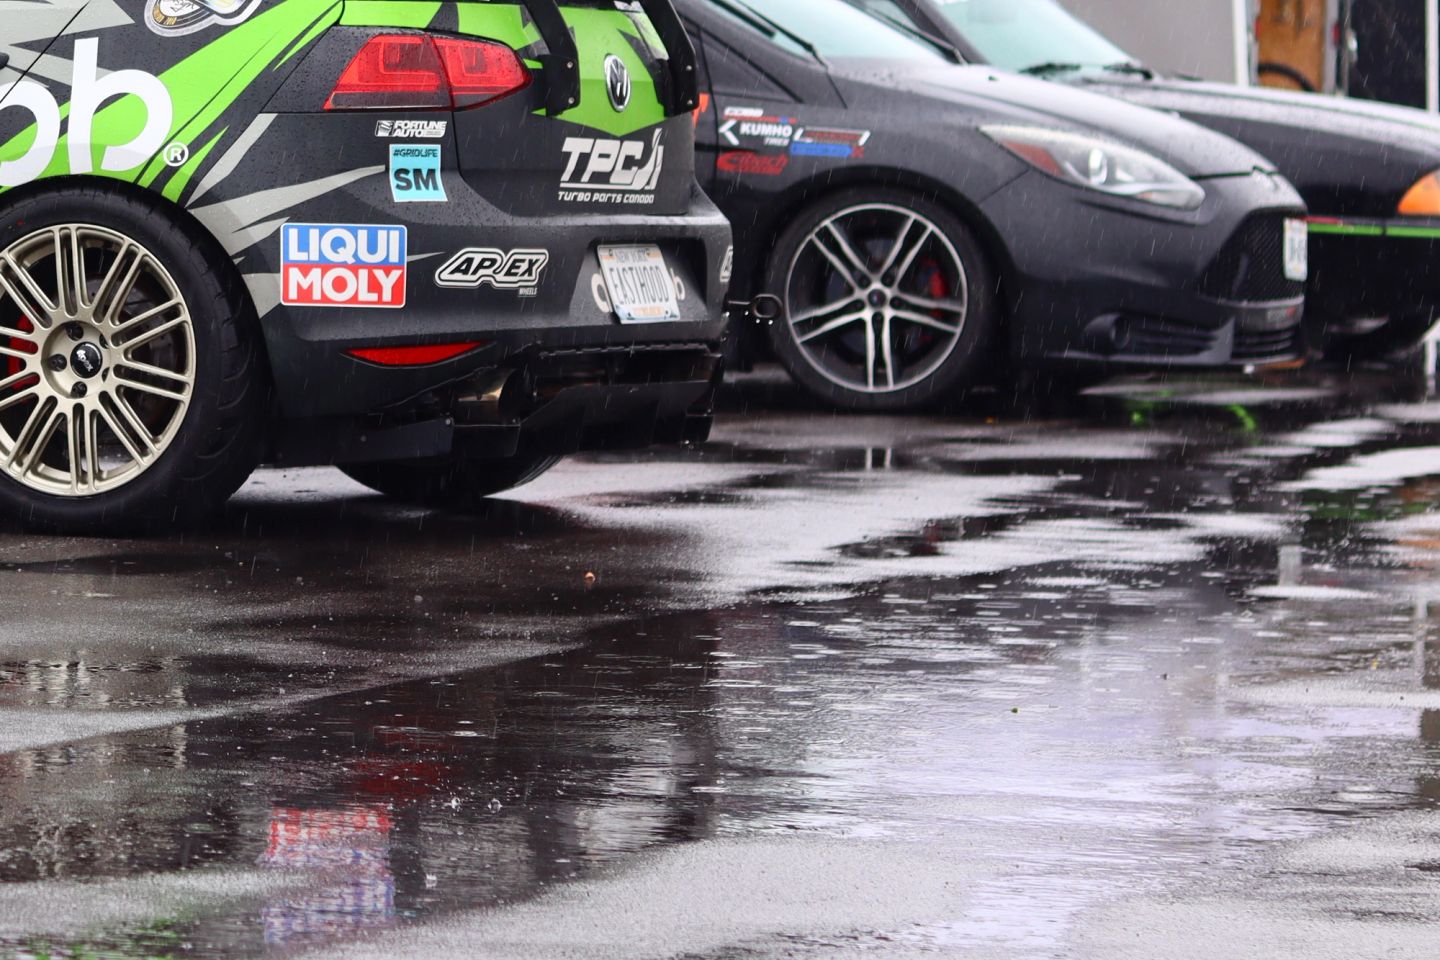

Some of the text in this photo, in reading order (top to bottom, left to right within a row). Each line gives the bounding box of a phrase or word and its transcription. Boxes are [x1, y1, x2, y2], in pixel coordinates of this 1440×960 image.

[392, 129, 423, 138] AUTO
[394, 120, 447, 130] FORTUNE
[740, 122, 793, 138] KUMHO
[393, 148, 439, 158] #GRIDLIFE
[393, 168, 439, 191] SM
[288, 228, 400, 265] LIQUI
[442, 253, 546, 281] APEX
[288, 267, 403, 302] MOLY
